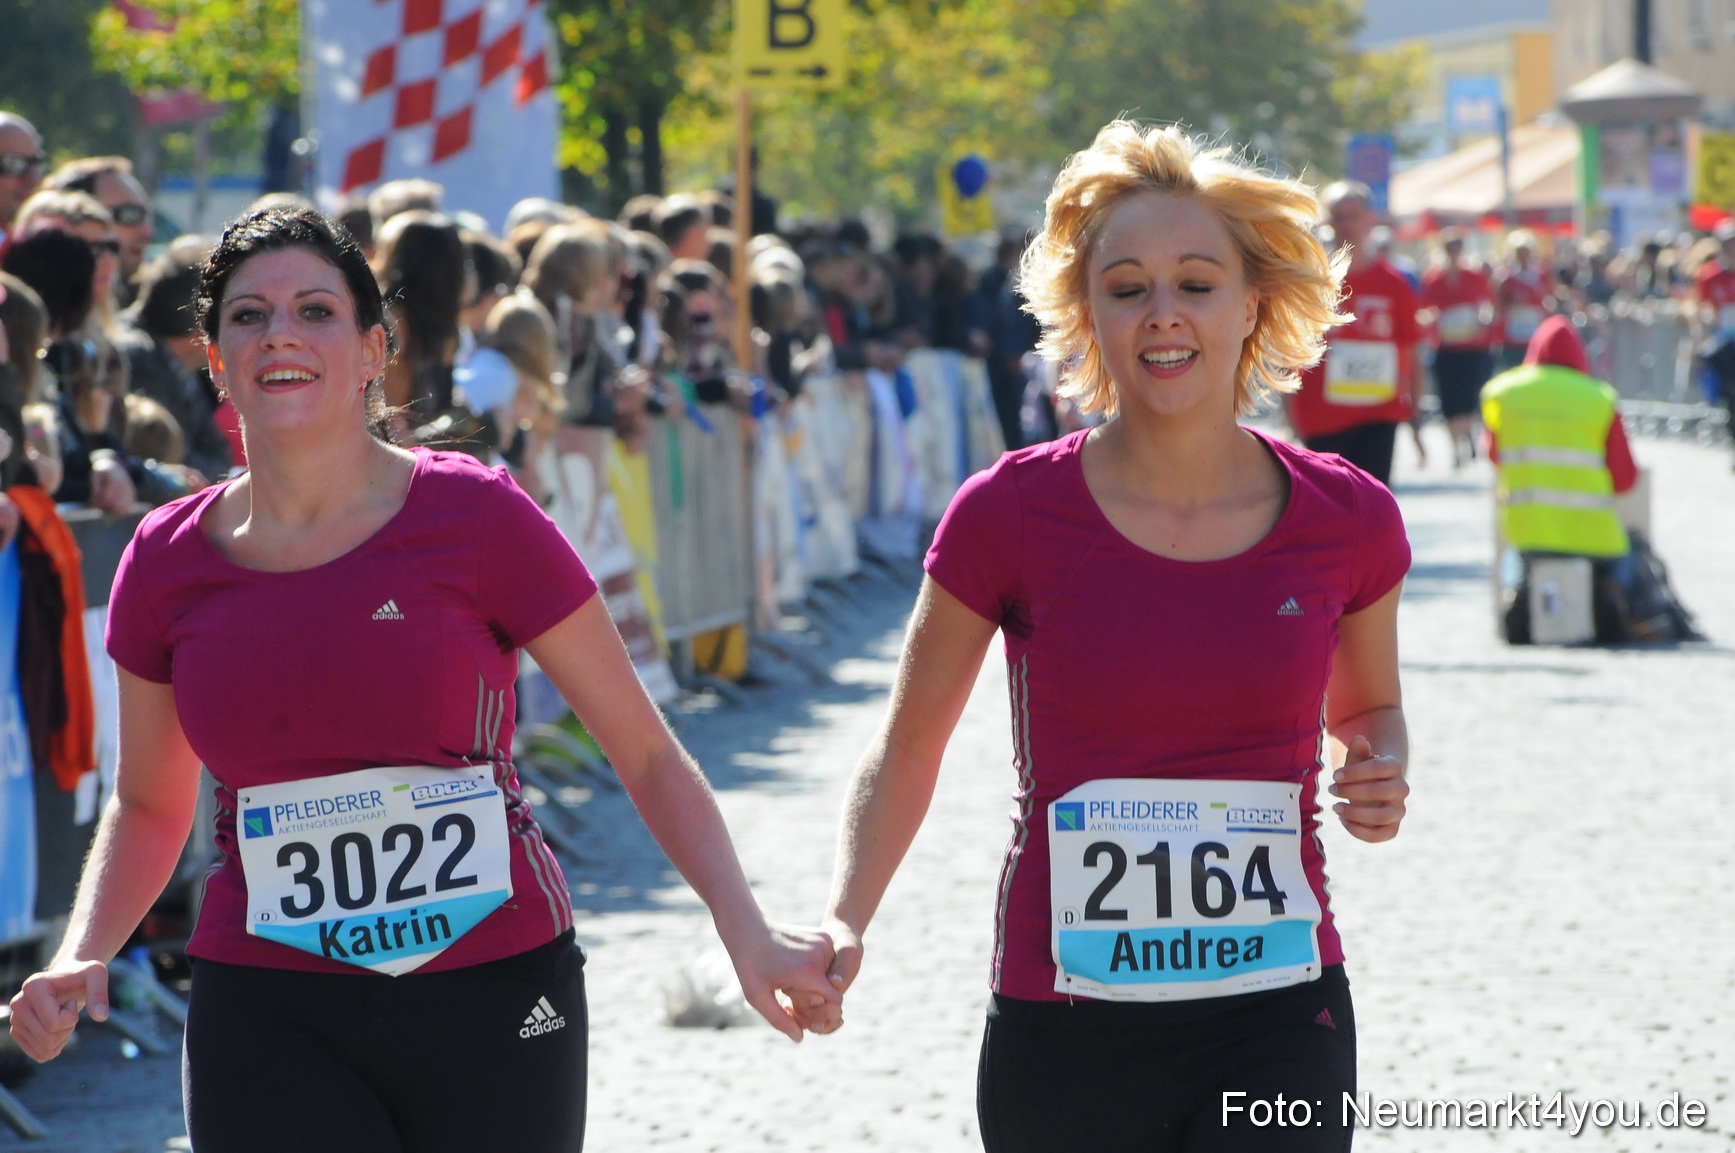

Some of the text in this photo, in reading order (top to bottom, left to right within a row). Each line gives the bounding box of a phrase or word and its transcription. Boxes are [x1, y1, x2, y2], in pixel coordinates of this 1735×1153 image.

[769, 0, 815, 49] B
[371, 611, 405, 620] adidas
[411, 780, 478, 801] BOCK
[274, 789, 385, 823] PFLEIDERER
[1089, 801, 1199, 820] PFLEIDERER
[1226, 807, 1285, 825] BOCK
[278, 809, 388, 835] AKTIENGESELLSCHAFT
[1089, 823, 1200, 833] AKTIENGESELLSCHAFT
[276, 813, 479, 919] 3022
[1083, 841, 1288, 921] 2164
[260, 912, 271, 922] D
[1064, 911, 1074, 925] D
[319, 909, 453, 959] Katrin
[1109, 929, 1265, 973] Andrea
[519, 1016, 566, 1039] adidas
